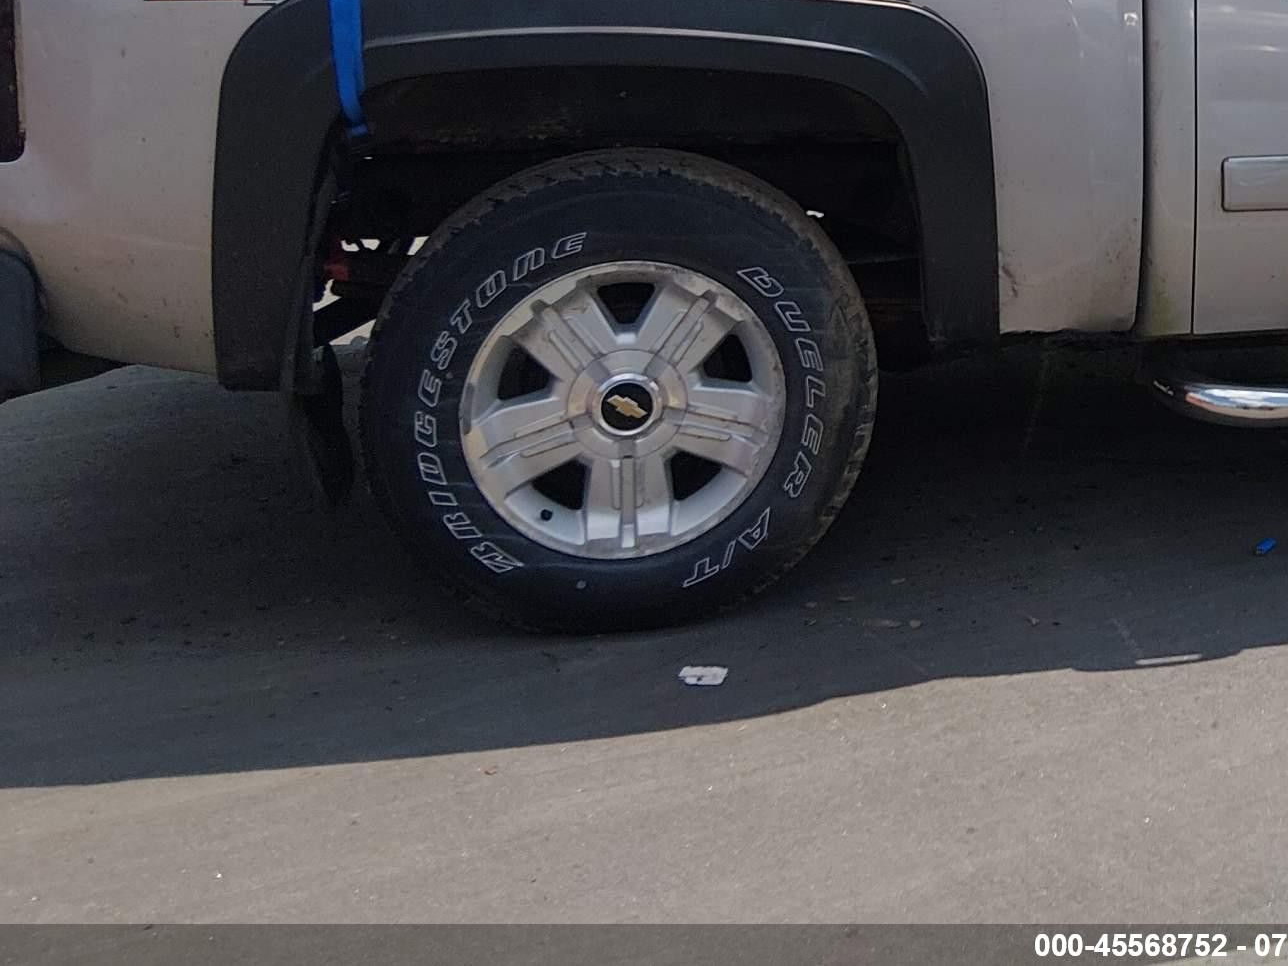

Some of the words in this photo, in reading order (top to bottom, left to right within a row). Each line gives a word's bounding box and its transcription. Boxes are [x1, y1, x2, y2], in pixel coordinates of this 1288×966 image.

[414, 232, 588, 574] BRIDGESTONE
[736, 266, 826, 499] DUELER
[681, 506, 771, 588] A/T
